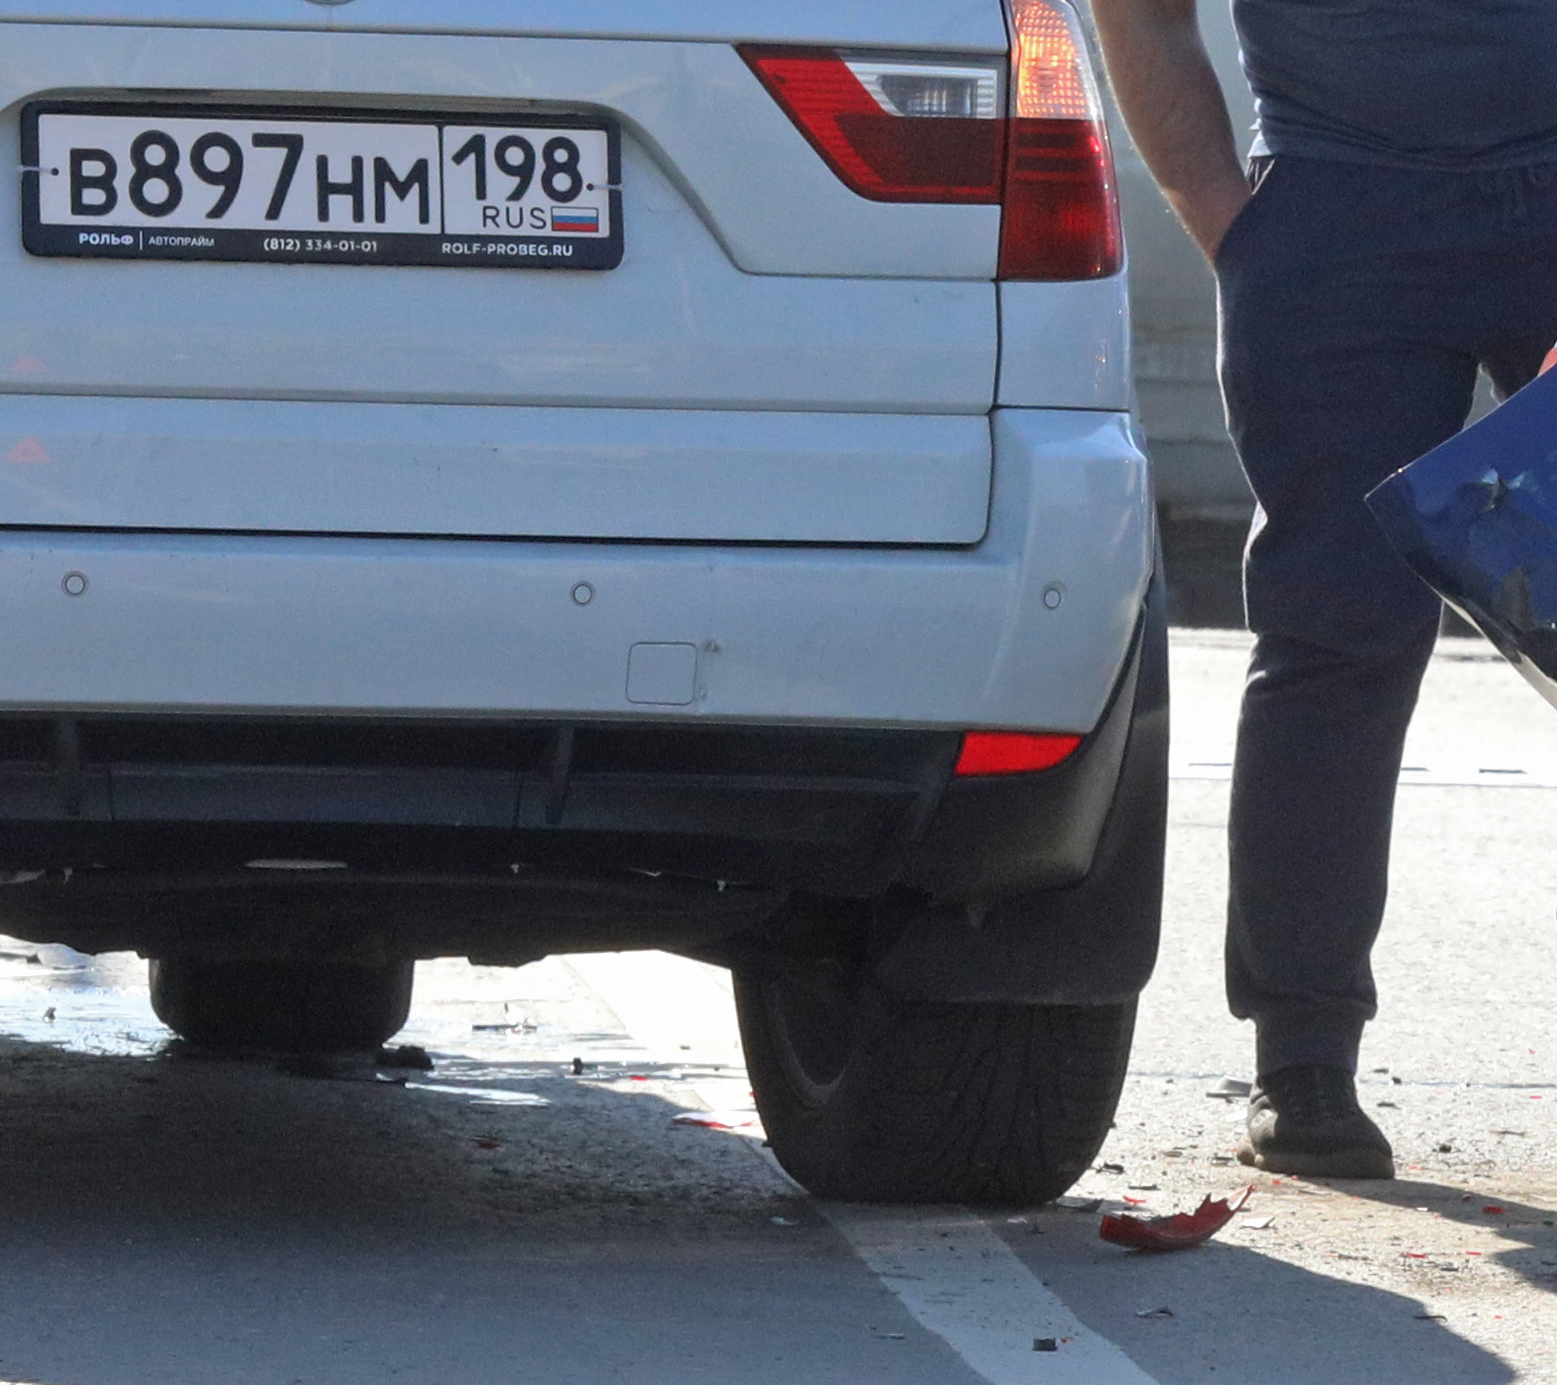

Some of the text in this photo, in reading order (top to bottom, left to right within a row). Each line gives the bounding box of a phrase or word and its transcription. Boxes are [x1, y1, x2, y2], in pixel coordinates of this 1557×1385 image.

[70, 129, 430, 225] В897НМ
[451, 133, 584, 204] 198
[482, 205, 547, 230] RUS
[78, 232, 215, 247] РОЛЬФ АВТОПРАЙМ
[263, 237, 378, 252] (812) 334-01-01
[442, 242, 574, 257] ROLF-PROBEG.RU
